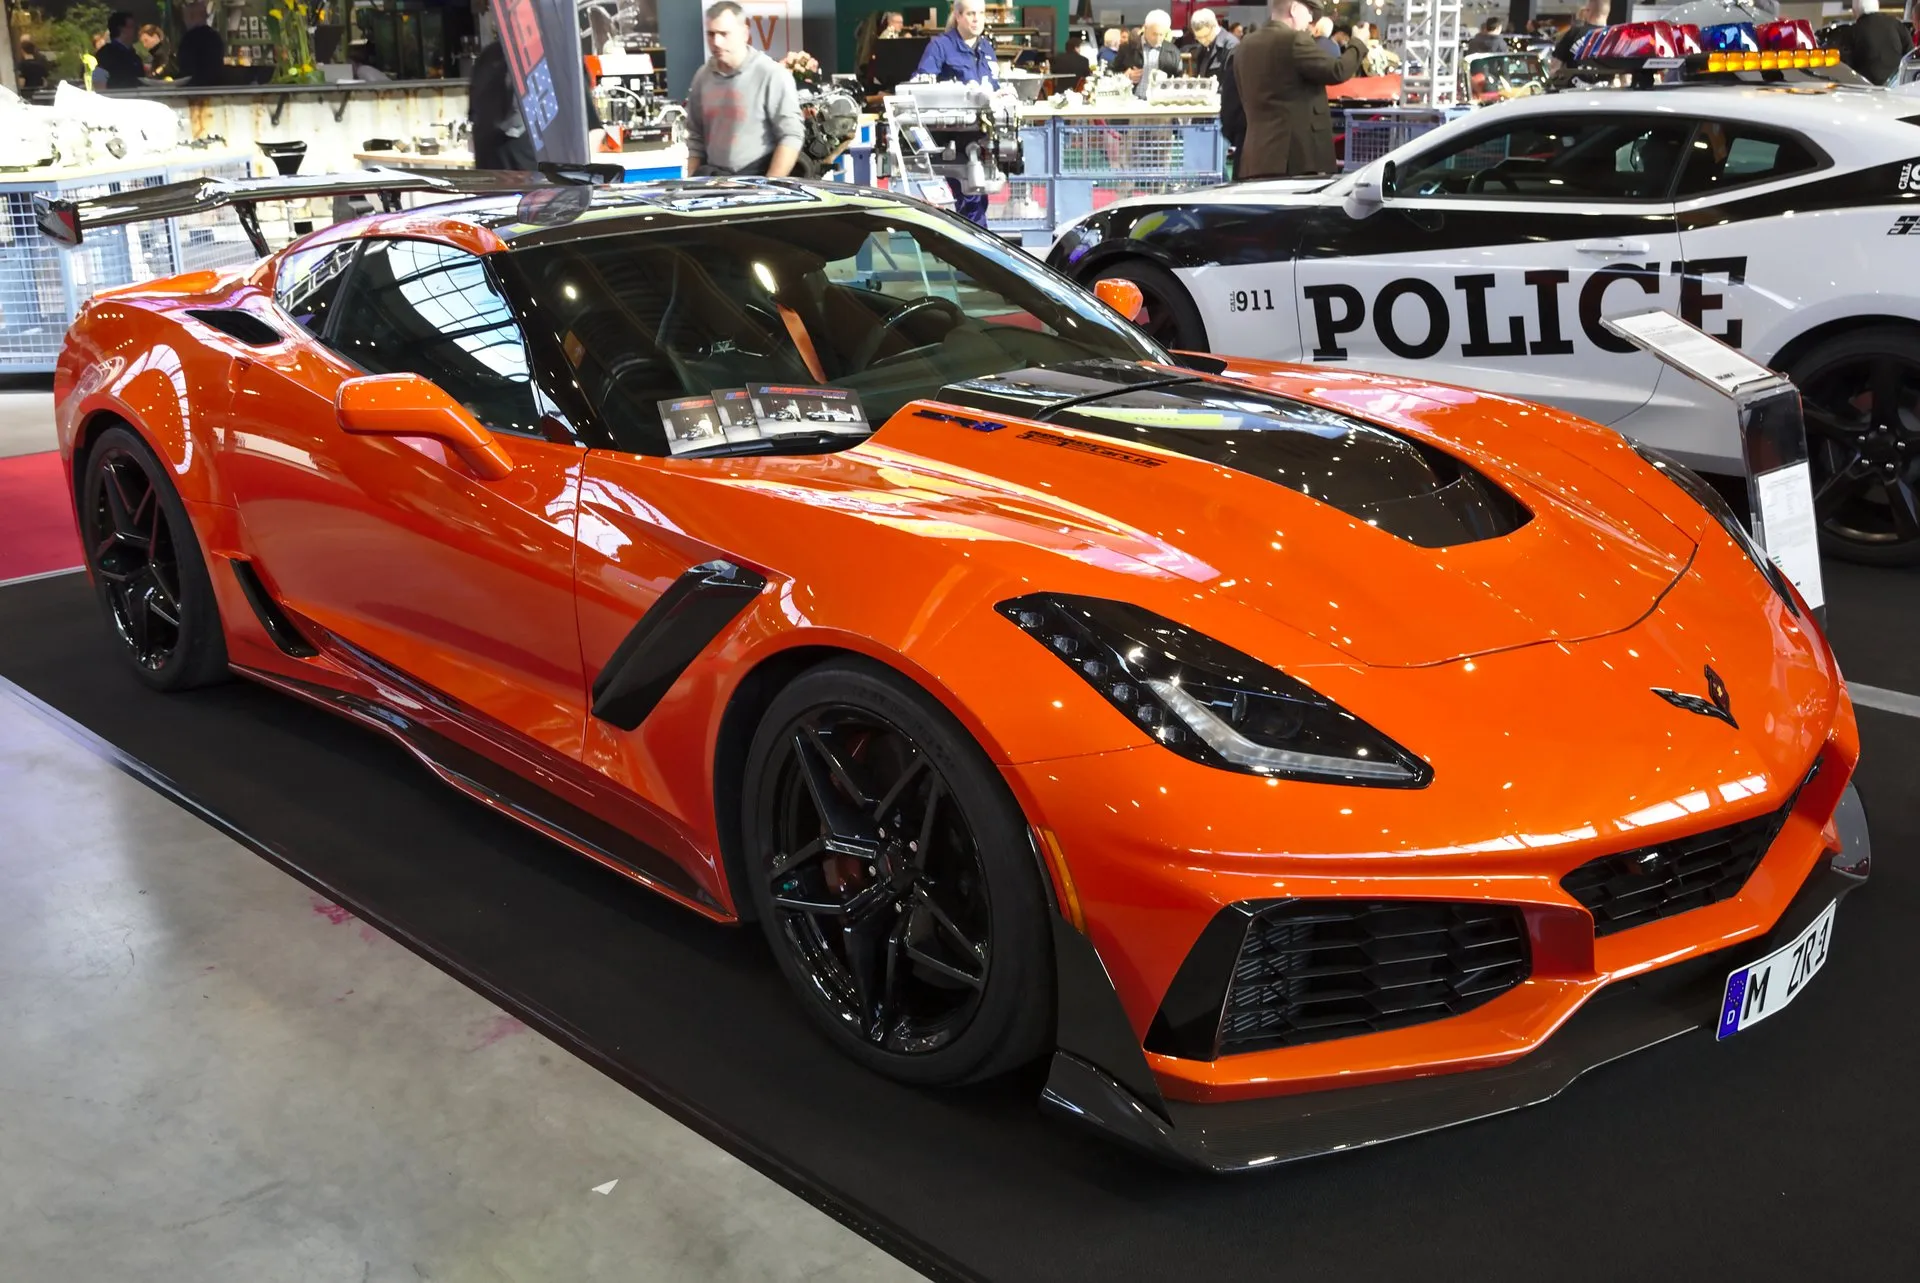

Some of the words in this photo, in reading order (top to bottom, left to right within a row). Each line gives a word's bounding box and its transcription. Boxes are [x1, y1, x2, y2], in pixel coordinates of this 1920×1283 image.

[1898, 162, 1912, 190] CALL
[1235, 288, 1275, 312] 911
[1303, 255, 1748, 362] POLICE
[1726, 1009, 1735, 1025] D
[1743, 966, 1771, 1020] M
[1786, 916, 1830, 997] ZR1
